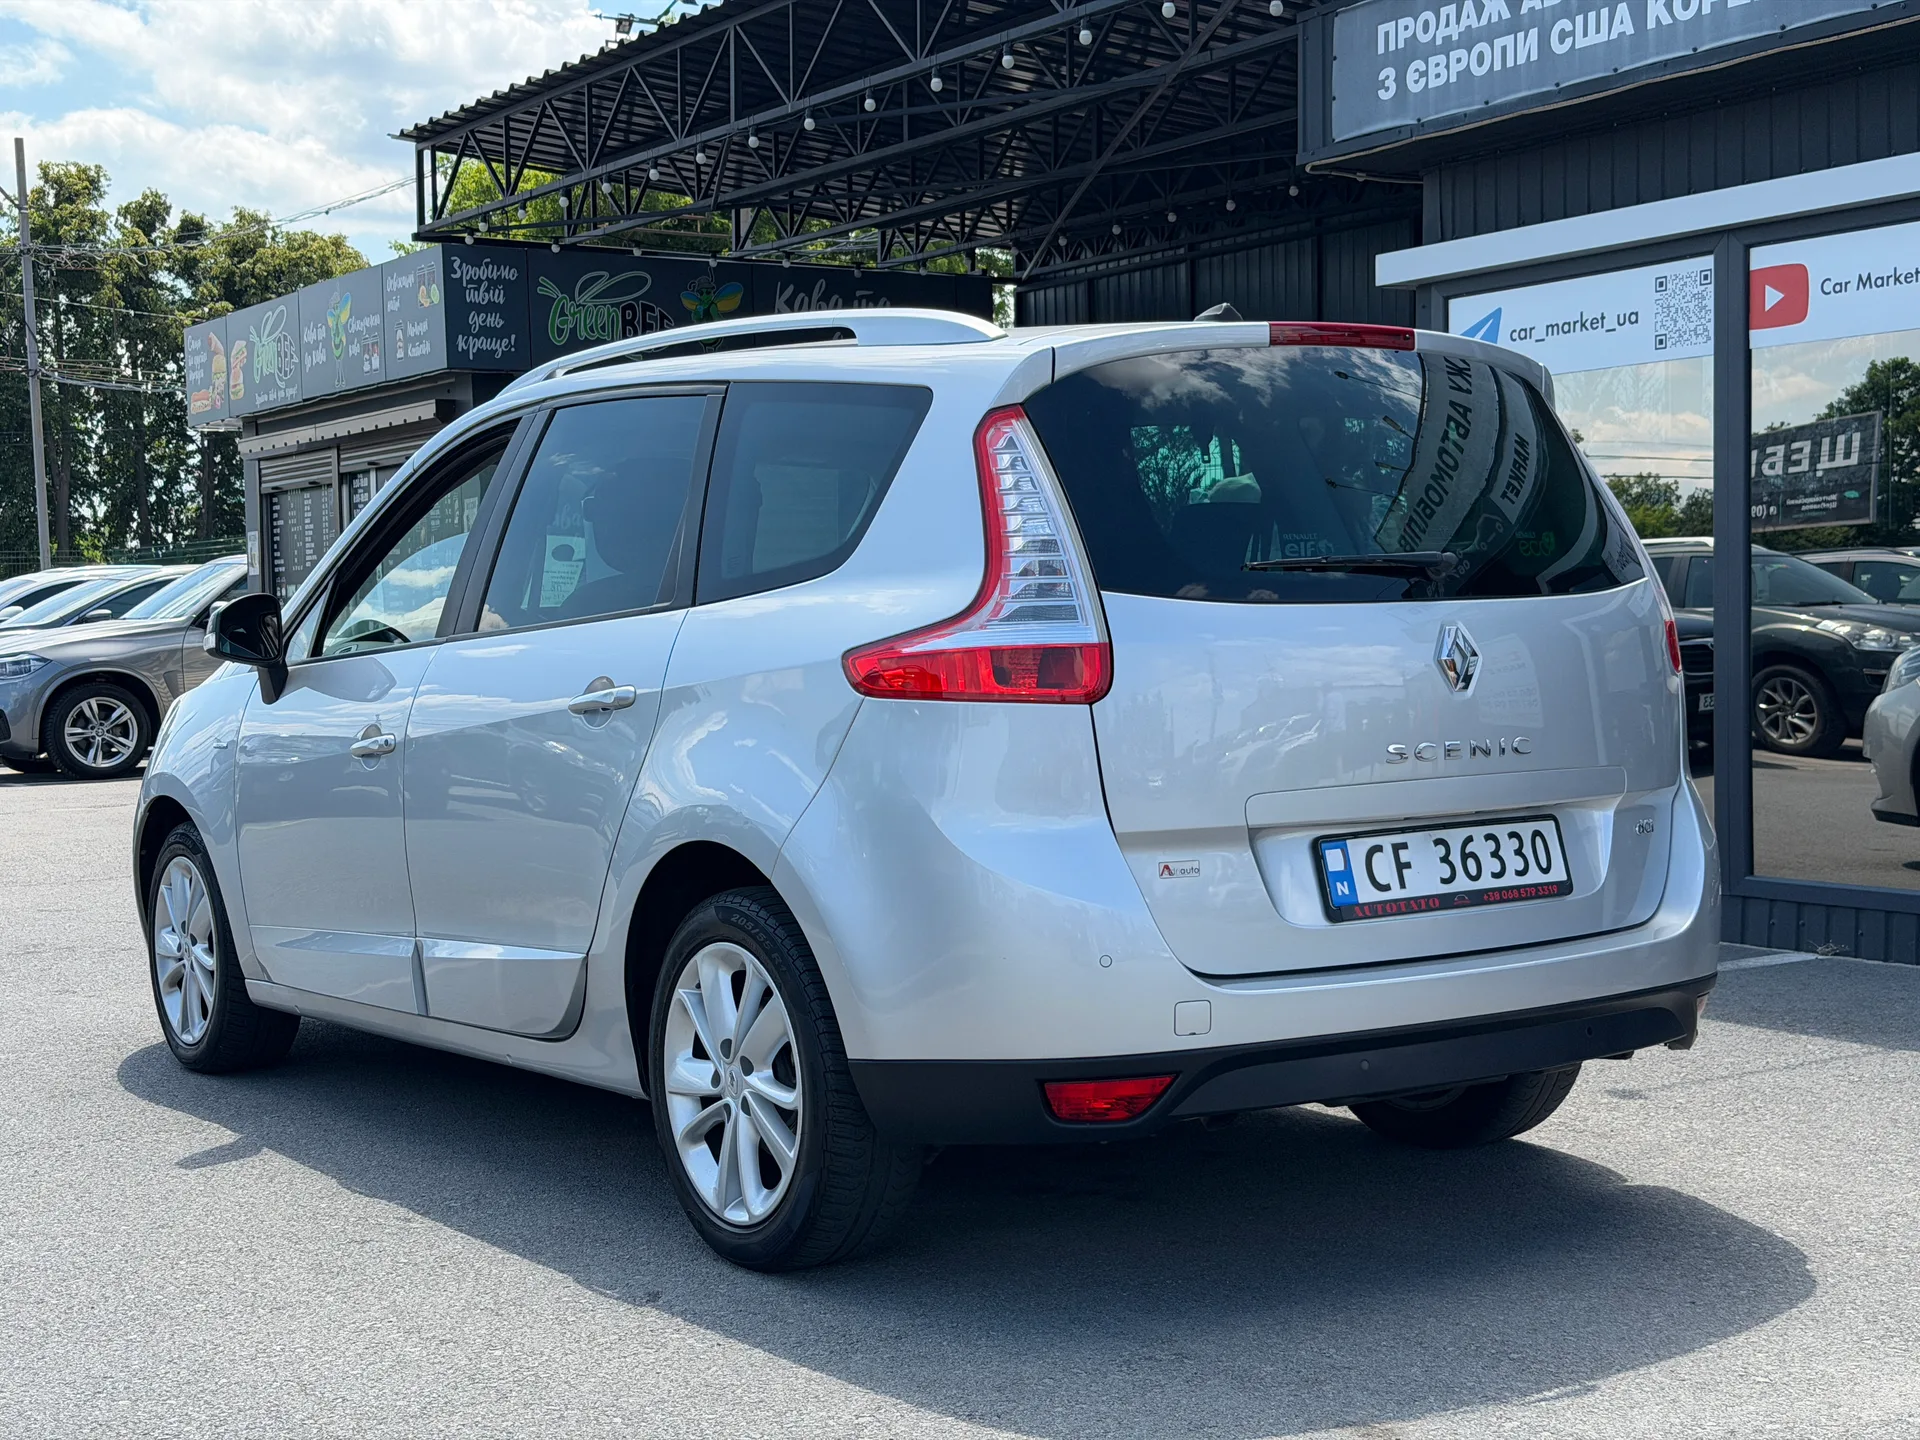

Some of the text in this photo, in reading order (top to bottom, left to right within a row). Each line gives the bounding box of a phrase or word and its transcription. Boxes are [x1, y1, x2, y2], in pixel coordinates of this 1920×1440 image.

[1377, 0, 1511, 55] ПРОДАЖ
[1377, 0, 1742, 100] З ЄВРОПИ США КО
[450, 256, 519, 287] Зробимо
[1820, 266, 1920, 296] Car Market
[465, 280, 505, 305] твій
[774, 278, 843, 314] Кава
[468, 310, 505, 334] день
[1509, 311, 1639, 343] car_market_ua
[456, 334, 516, 360] краще!
[1385, 736, 1533, 765] SCENIC
[1364, 828, 1553, 893] CF 36330
[1336, 882, 1349, 896] N
[1483, 884, 1558, 902] +38 068 579 3319
[1353, 897, 1440, 918] AUTOTATO
